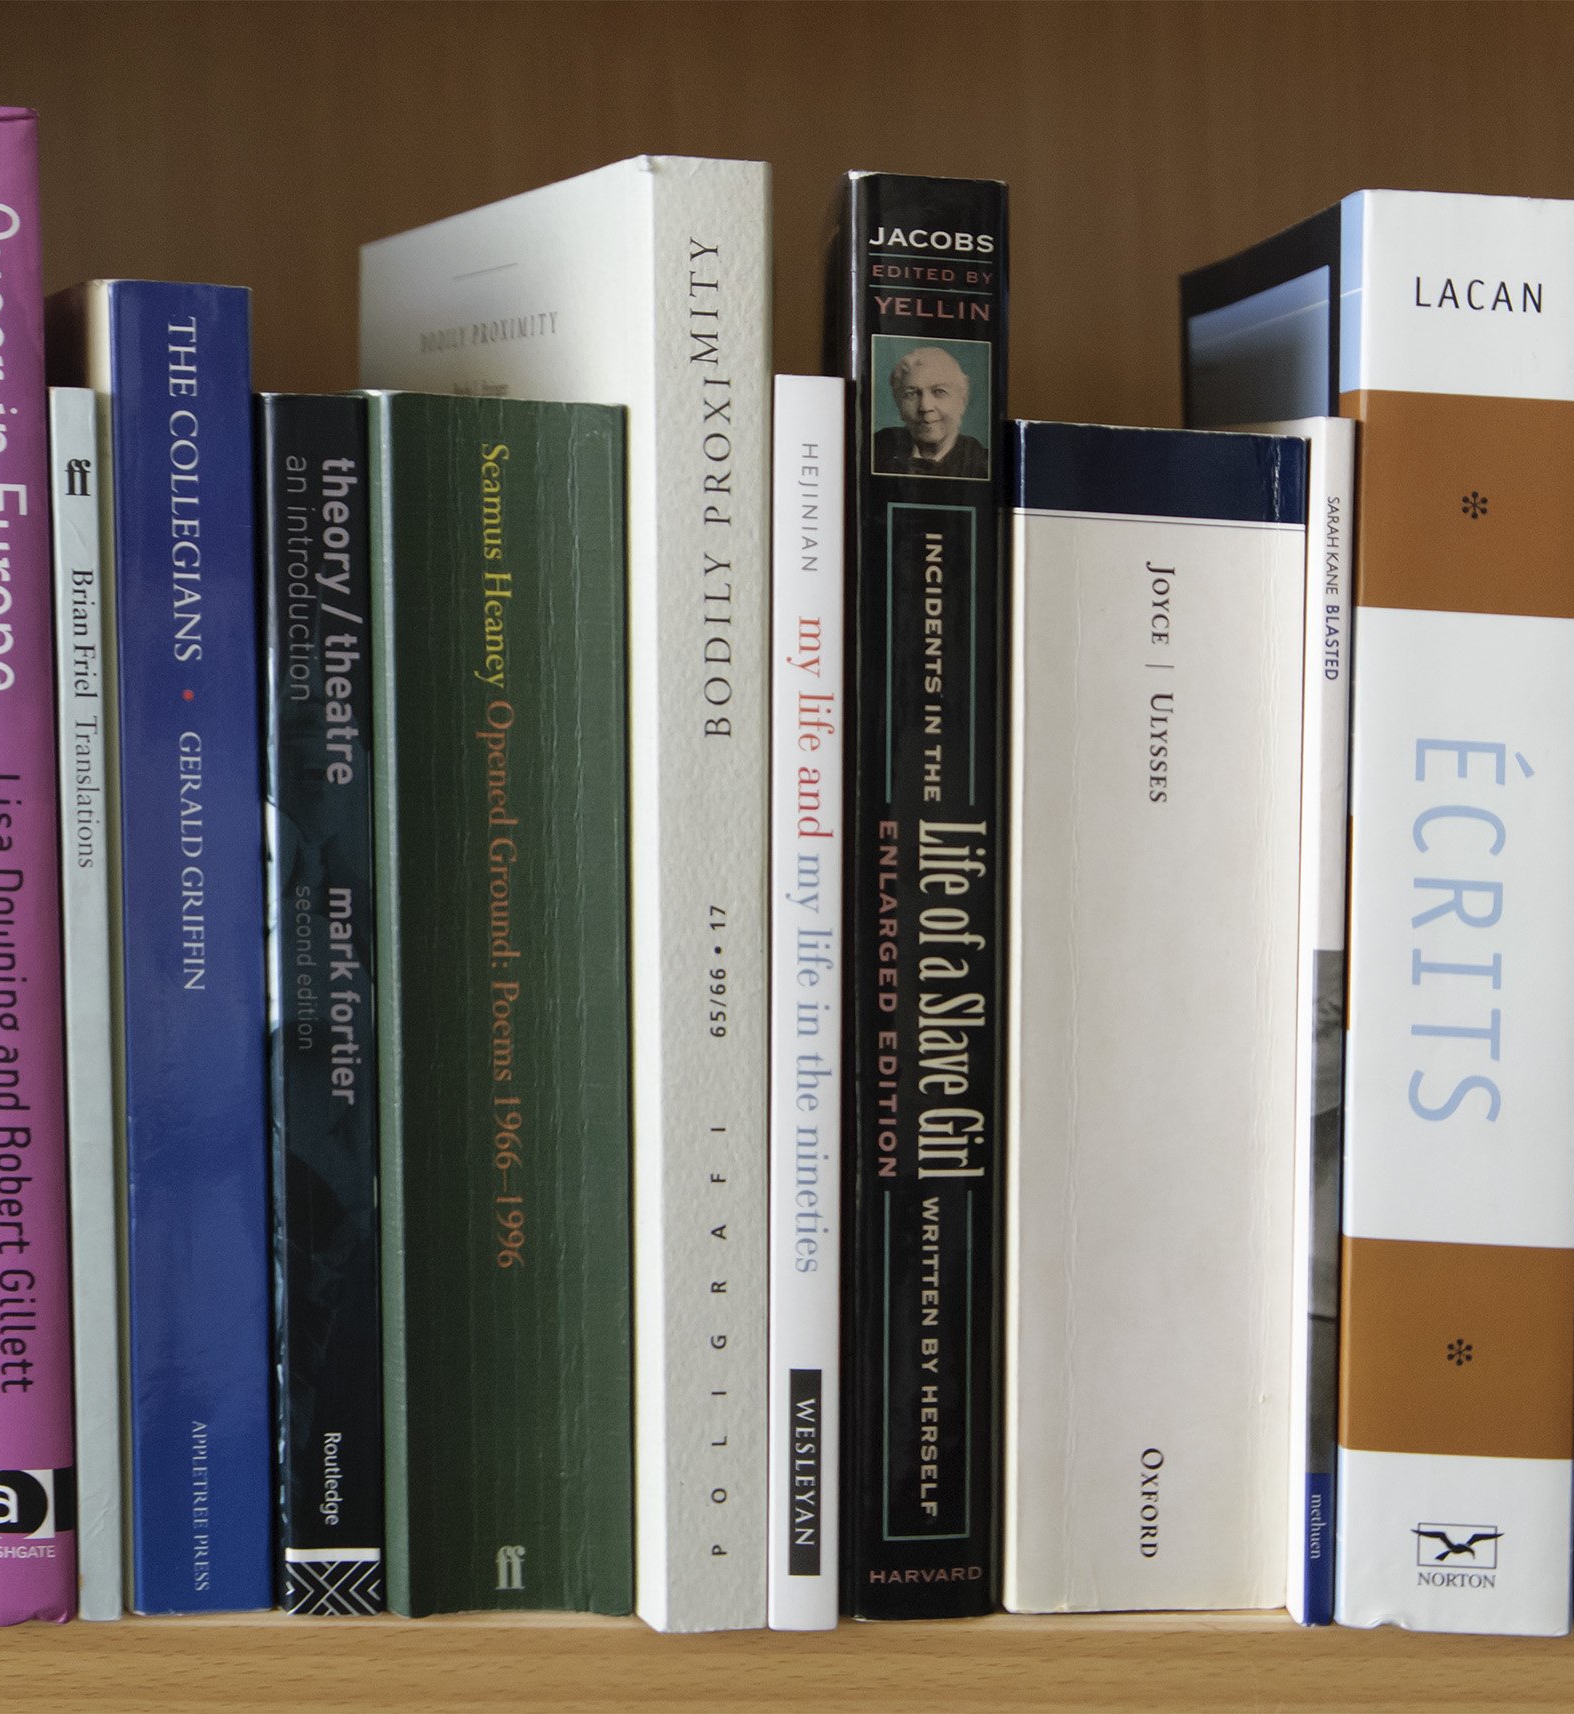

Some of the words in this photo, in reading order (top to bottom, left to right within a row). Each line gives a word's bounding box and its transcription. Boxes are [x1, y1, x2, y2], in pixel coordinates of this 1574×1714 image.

[868, 226, 994, 253] JACOBS
[874, 296, 989, 321] YELLIN
[1415, 276, 1543, 314] LACAN
[168, 316, 198, 397] THE
[689, 238, 732, 525] PROXIMITY
[169, 409, 202, 662] COLLEGIANS
[314, 457, 358, 595] theory
[481, 444, 509, 559] Seamus
[798, 443, 819, 572] HEJINIAN
[1326, 496, 1340, 548] SARAH
[72, 568, 96, 637] Brian
[1145, 560, 1176, 644] JOYCE
[1325, 552, 1339, 595] KANE
[73, 645, 98, 699] Friel
[474, 572, 512, 688] Heaney
[703, 553, 732, 737] BODILY
[1324, 605, 1340, 681] BLASTED
[325, 633, 359, 784] theatre
[477, 700, 519, 825] Opened
[1149, 693, 1174, 803] ULYSSES
[75, 715, 101, 869] Translations
[177, 730, 204, 863] GERALD
[181, 866, 206, 990] GRIFFIN
[329, 888, 359, 981] mark
[486, 836, 521, 967] Ground:
[1407, 737, 1535, 1123] ÉCRITS
[331, 991, 360, 1105] fortier
[492, 982, 520, 1081] Poems
[709, 1127, 728, 1557] POLIGRAFI
[192, 1421, 209, 1523] APPLETREE
[321, 1433, 341, 1526] Routledge
[794, 1398, 816, 1545] WESLEYAN
[1140, 1447, 1164, 1559] OXFORD
[193, 1535, 209, 1591] PRESS
[869, 1566, 982, 1584] HARVARD
[1311, 1494, 1326, 1560] methuen
[1418, 1571, 1496, 1589] NORTON
